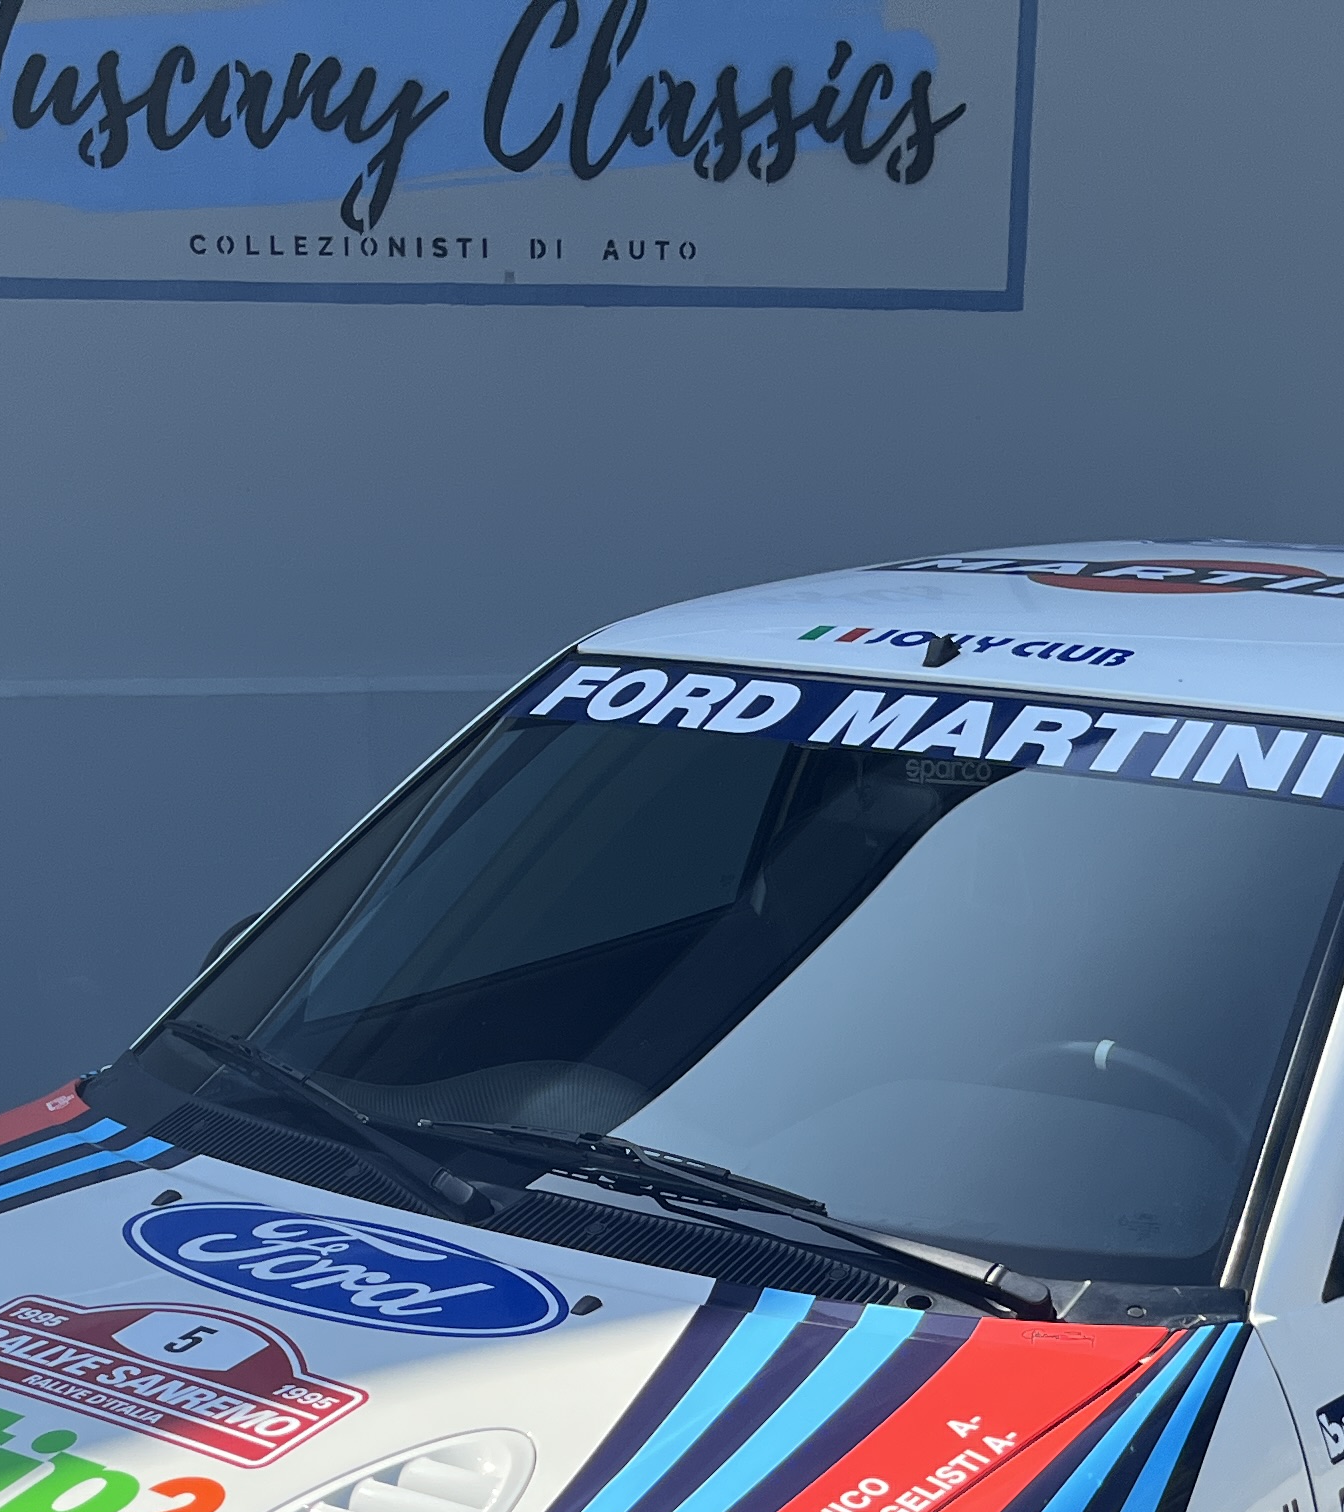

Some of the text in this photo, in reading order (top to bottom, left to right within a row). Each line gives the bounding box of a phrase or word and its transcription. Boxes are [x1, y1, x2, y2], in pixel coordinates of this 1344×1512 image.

[482, 0, 967, 185] Classics
[189, 233, 699, 263] COLLEZIONISTI DI AUTO
[864, 629, 1136, 667] JOLY CLUB
[529, 664, 801, 734] FORD
[905, 759, 992, 784] sparco
[178, 1218, 495, 1317] Ford
[8, 1306, 69, 1327] 1995
[164, 1325, 219, 1354] 5
[22, 1373, 167, 1424] RALLYE D'ITALIA
[97, 1365, 301, 1437] SANREMO
[270, 1383, 341, 1410] 1995
